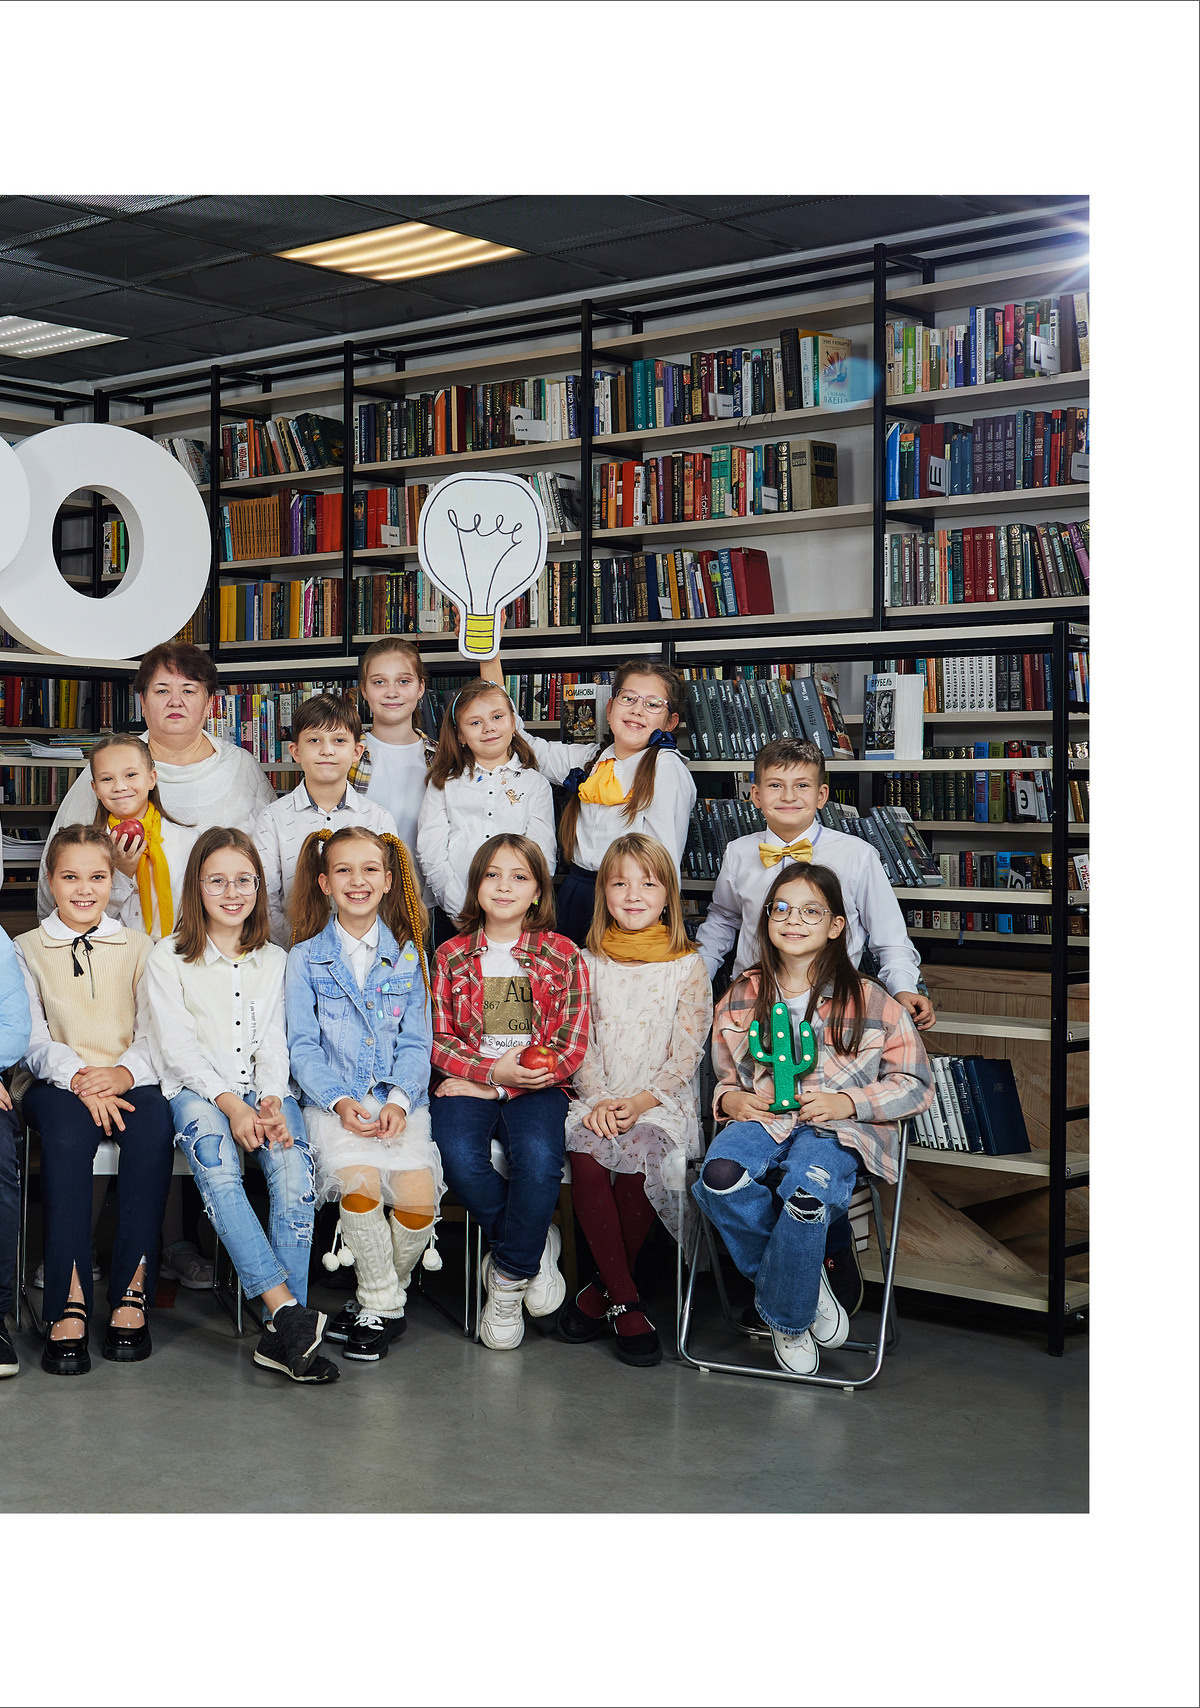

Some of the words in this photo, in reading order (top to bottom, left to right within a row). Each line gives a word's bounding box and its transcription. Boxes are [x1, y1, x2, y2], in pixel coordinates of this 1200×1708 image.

[565, 688, 594, 697] РОМАНОВЫ
[871, 678, 892, 687] ВРУБЕЛЬ
[753, 704, 762, 727] ПИКАССО
[806, 705, 816, 726] ЛЕНИН
[1019, 789, 1029, 810] Э
[690, 823, 701, 848] ЛЮТЕР
[504, 980, 533, 1003] Au
[483, 1001, 500, 1010] 867
